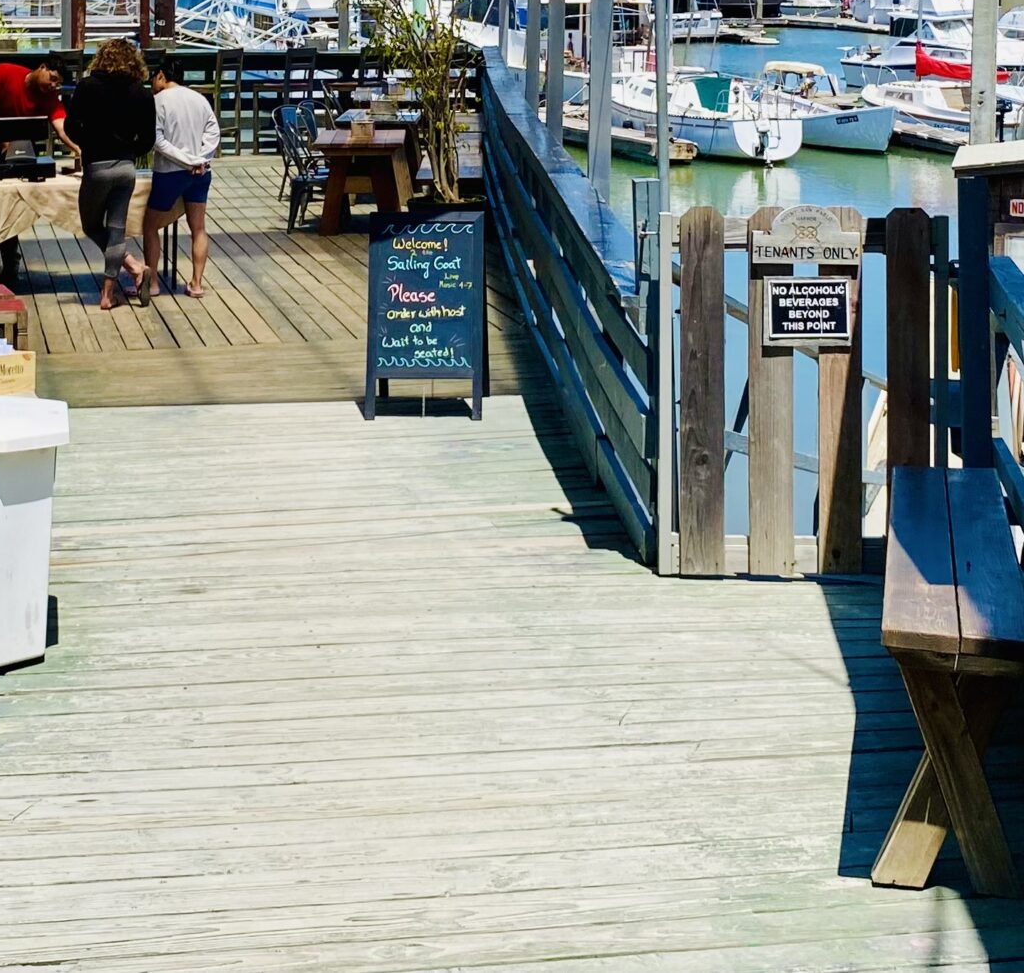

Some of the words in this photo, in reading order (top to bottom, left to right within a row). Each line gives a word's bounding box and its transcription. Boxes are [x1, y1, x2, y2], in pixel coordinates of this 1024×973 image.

[392, 236, 449, 252] Welcome!
[756, 245, 815, 259] TENANTS
[823, 246, 856, 260] ONLY
[387, 255, 430, 279] Sailing
[433, 255, 462, 270] Goat
[387, 283, 436, 303] Please
[772, 286, 787, 295] NO
[789, 284, 845, 296] ALCOHOLIC
[779, 297, 839, 307] BEVERAGES
[788, 309, 830, 319] BEYOND
[409, 321, 432, 333] and
[782, 321, 804, 331] THIS
[806, 321, 836, 331] POINT
[382, 335, 409, 348] Wait
[412, 335, 424, 346] to
[426, 335, 438, 346] be
[414, 347, 454, 359] seated!
